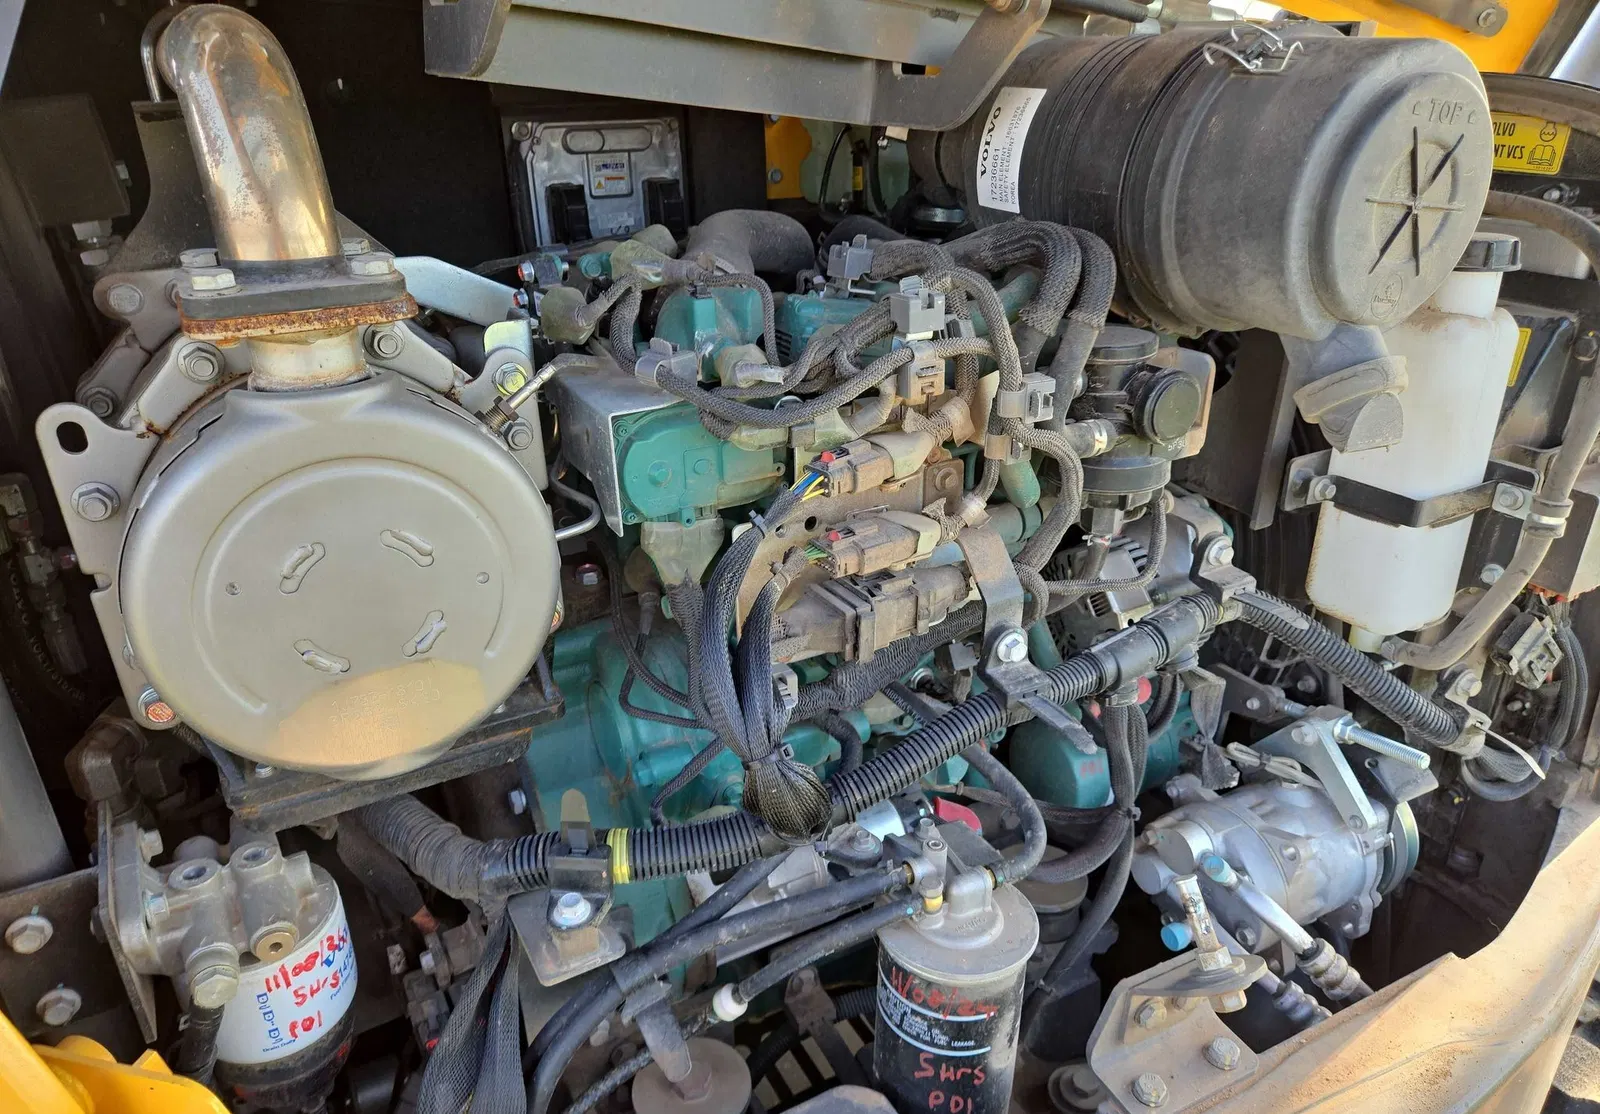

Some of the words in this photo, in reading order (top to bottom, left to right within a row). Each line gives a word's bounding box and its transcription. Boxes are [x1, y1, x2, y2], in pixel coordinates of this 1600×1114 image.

[1428, 98, 1463, 125] TOP
[980, 106, 1001, 178] VOLVO
[1005, 137, 1015, 173] ELEMENT
[1507, 145, 1525, 159] VCS
[991, 147, 1001, 201] 17236661
[999, 147, 1007, 182] ELEMENT
[928, 1090, 973, 1114] PDI
